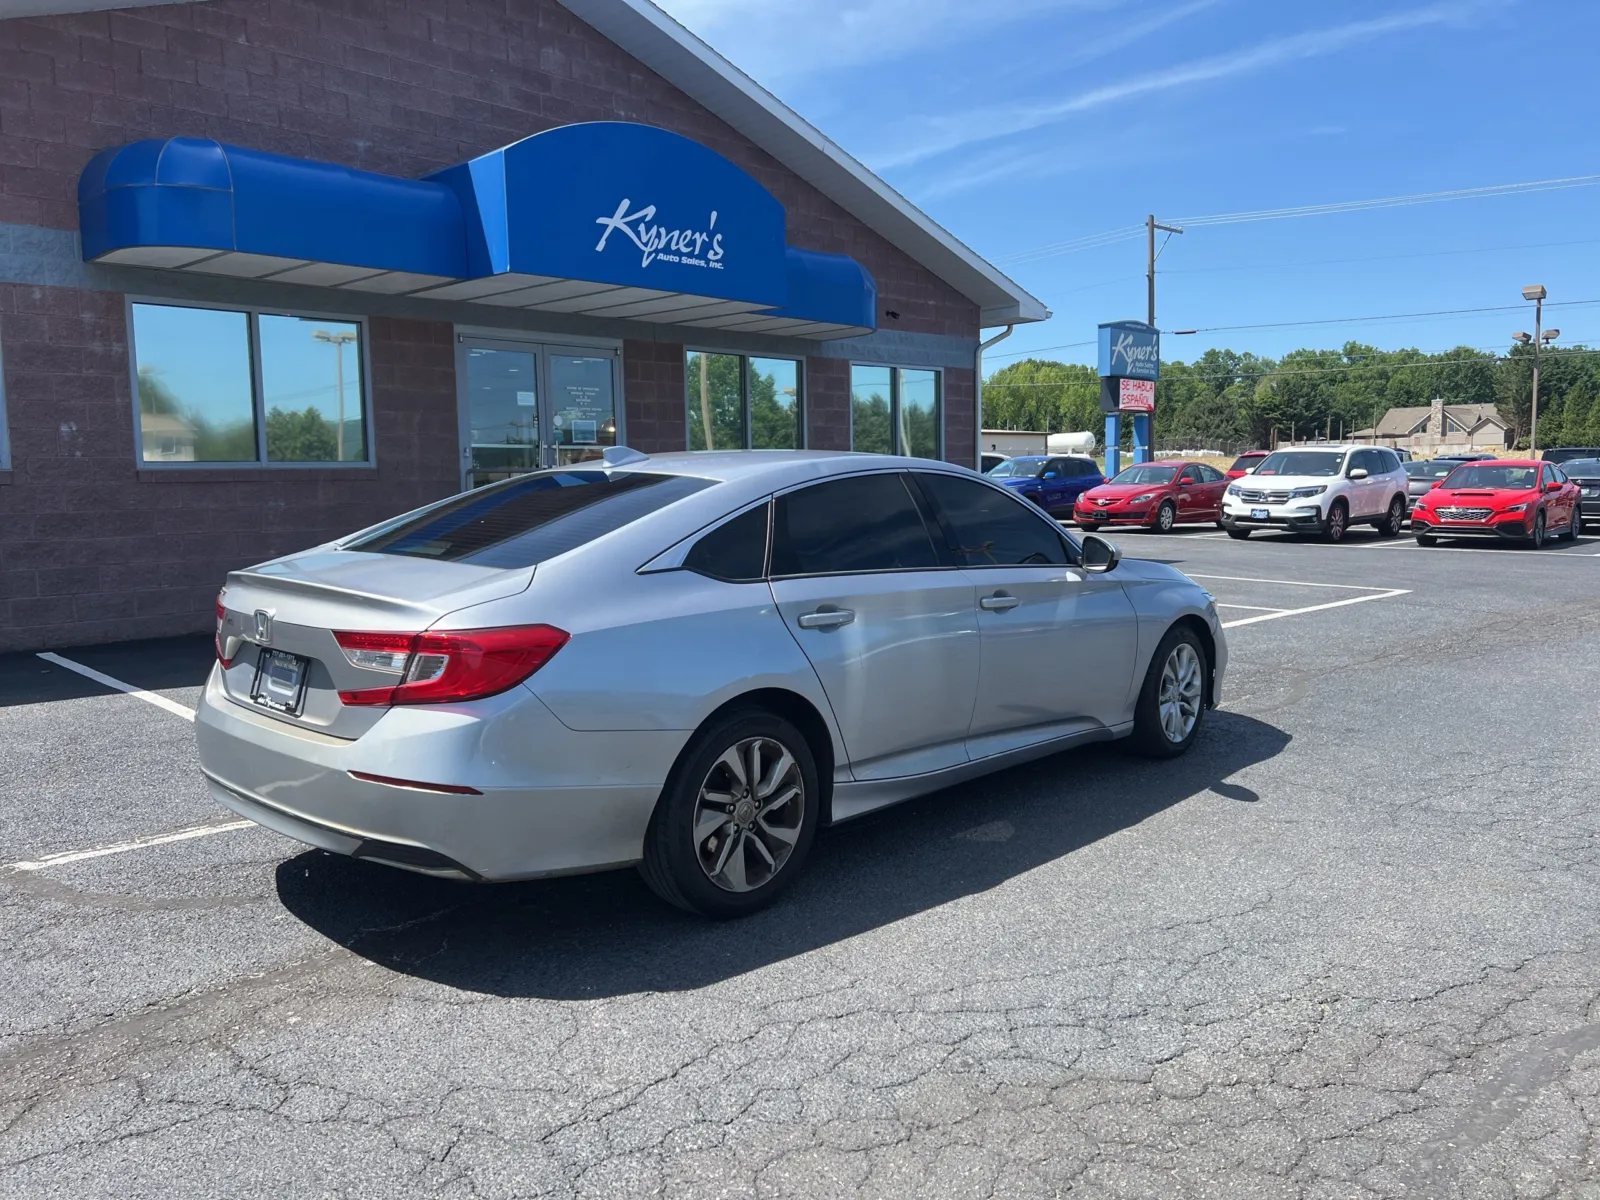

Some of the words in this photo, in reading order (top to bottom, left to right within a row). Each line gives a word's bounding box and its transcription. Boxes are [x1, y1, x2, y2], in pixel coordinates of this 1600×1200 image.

[595, 198, 724, 268] Kyner's
[657, 253, 680, 263] Auto
[681, 256, 707, 268] Sales,
[709, 260, 724, 269] Inc.
[1112, 333, 1157, 375] Kyner's
[1121, 380, 1130, 391] SE
[1132, 381, 1153, 393] HABLA
[1121, 394, 1149, 405] ESPAÑOL
